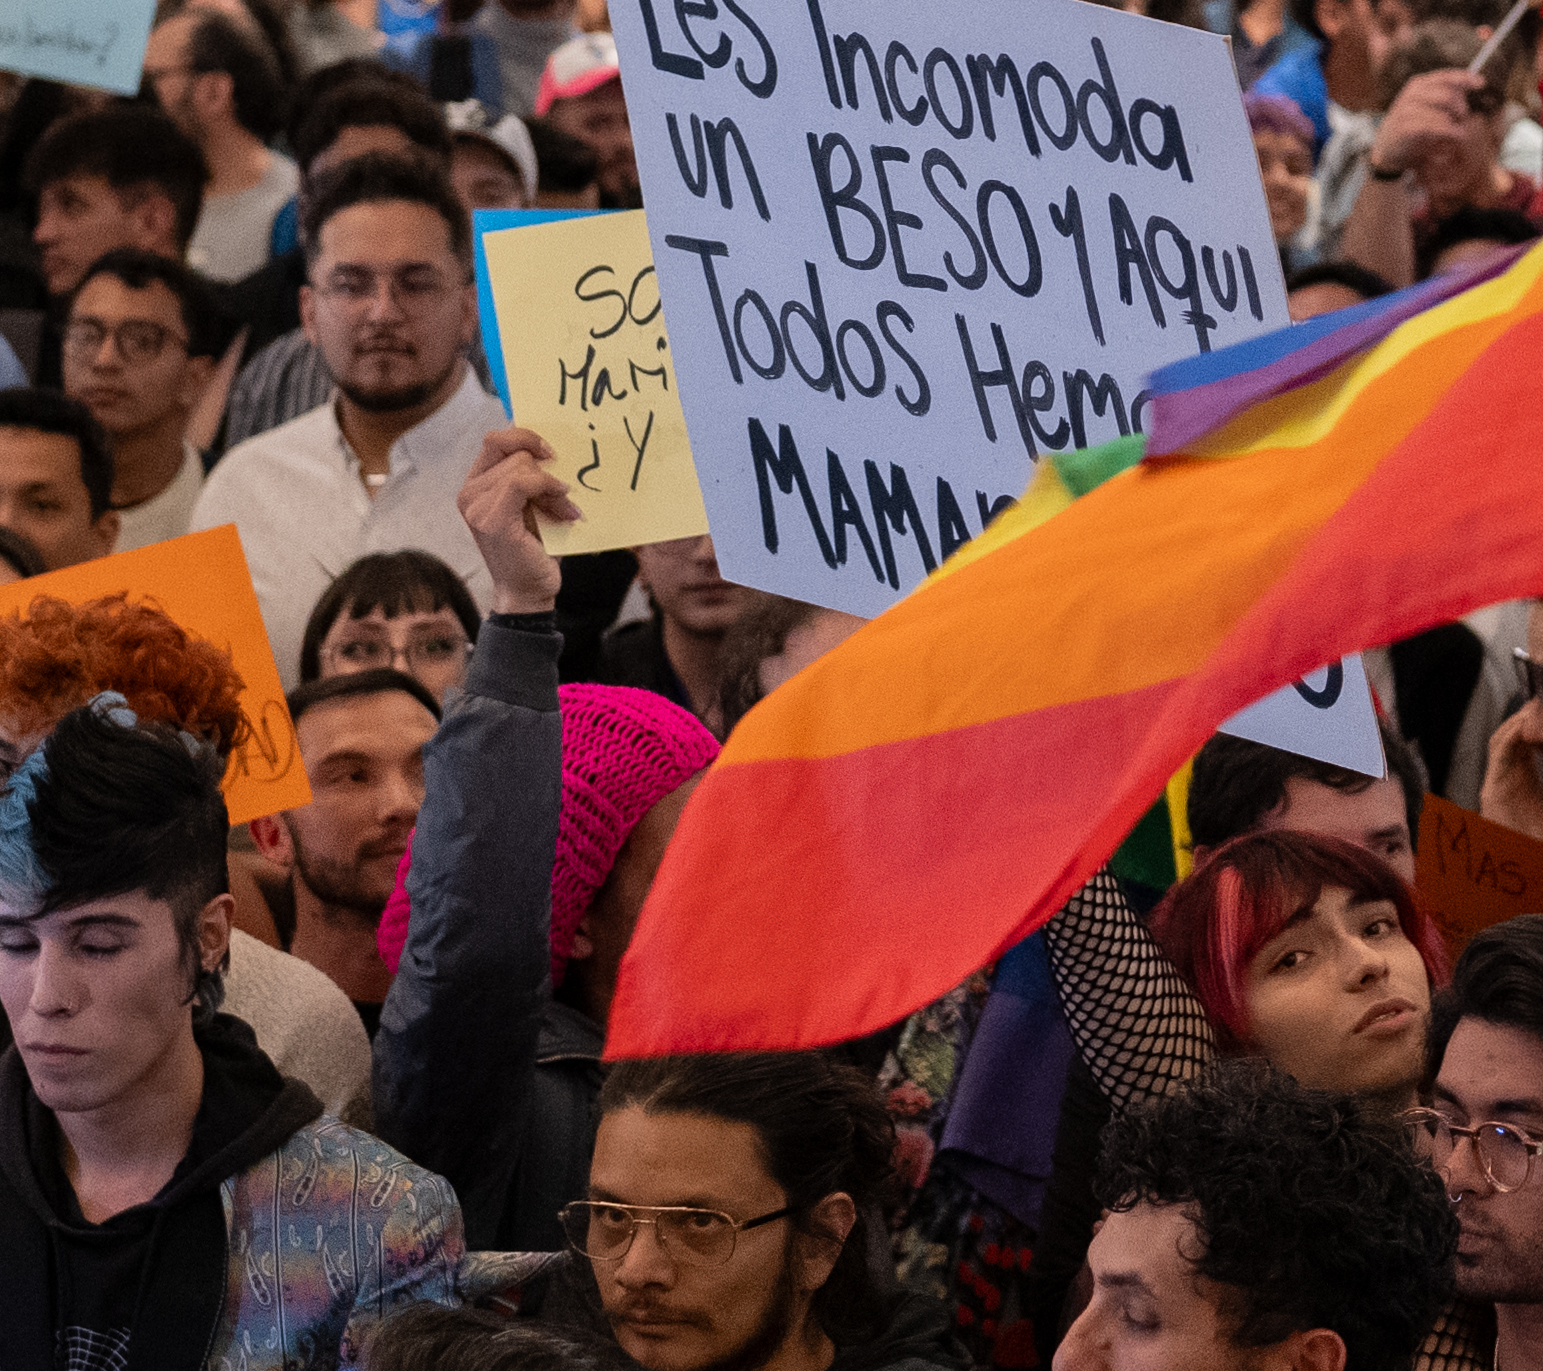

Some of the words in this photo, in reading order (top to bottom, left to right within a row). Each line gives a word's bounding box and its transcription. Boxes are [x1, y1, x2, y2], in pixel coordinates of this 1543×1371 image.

[665, 111, 772, 223] un
[806, 131, 1044, 298] BESO
[664, 234, 933, 418] Todos
